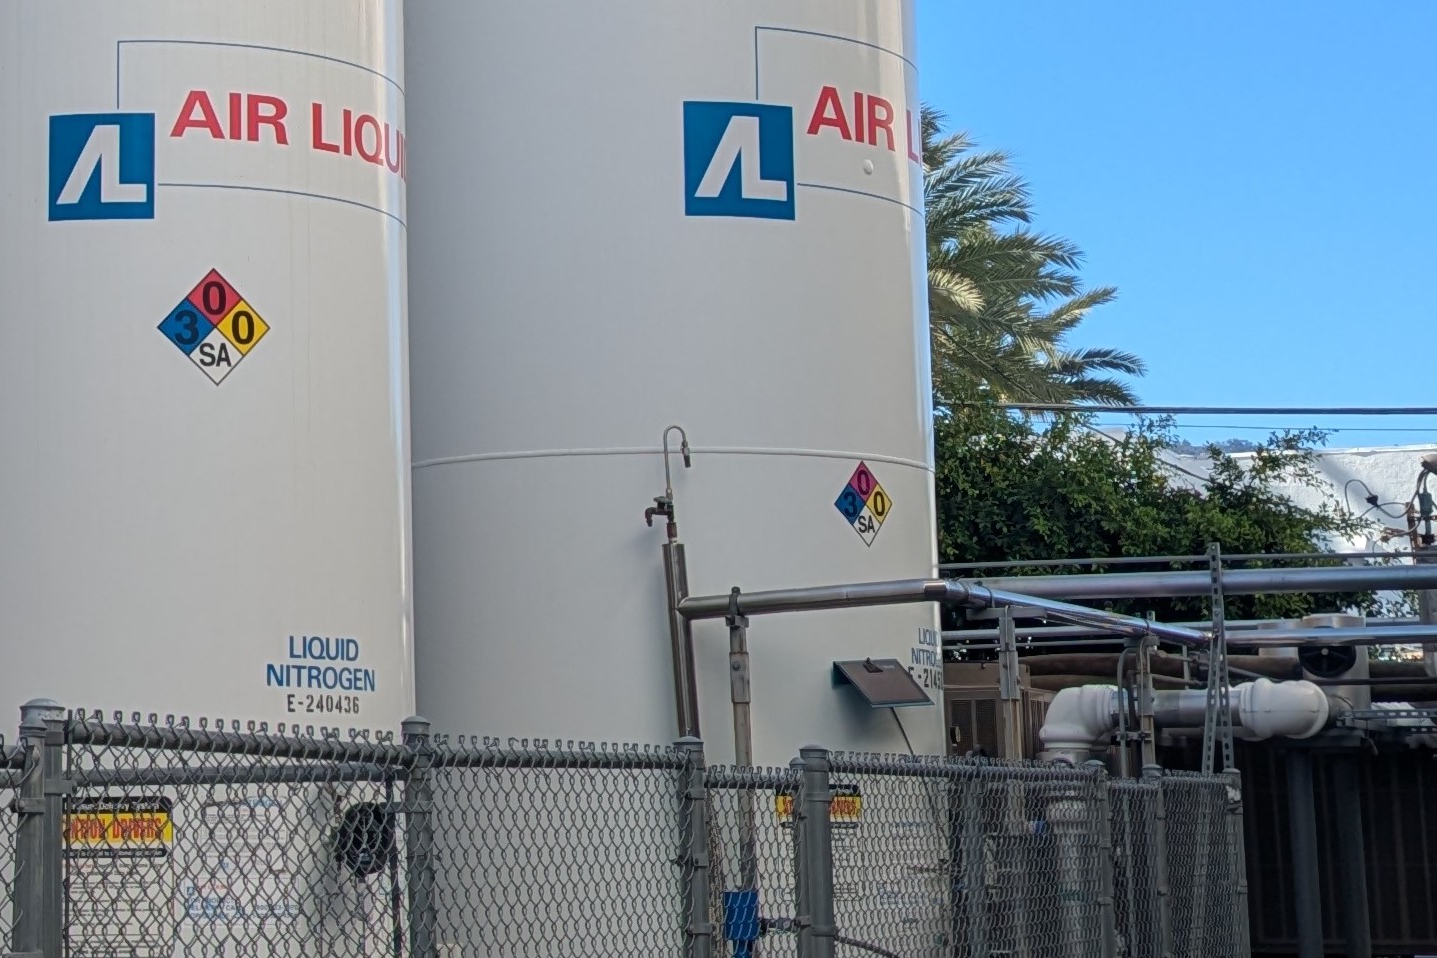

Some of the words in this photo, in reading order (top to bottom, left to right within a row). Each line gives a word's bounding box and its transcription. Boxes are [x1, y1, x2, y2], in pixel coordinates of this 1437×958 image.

[170, 90, 289, 145] AIR
[806, 86, 896, 152] AIR
[202, 281, 226, 316] 0
[174, 310, 200, 345] 3
[232, 310, 255, 345] 0
[199, 343, 232, 367] SA
[857, 470, 870, 495] 0
[844, 491, 858, 517] 3
[874, 491, 885, 516] 0
[858, 515, 876, 533] SA
[289, 636, 359, 661] LIQUID
[266, 663, 375, 692] NITROGEN
[287, 694, 360, 714] E-240436
